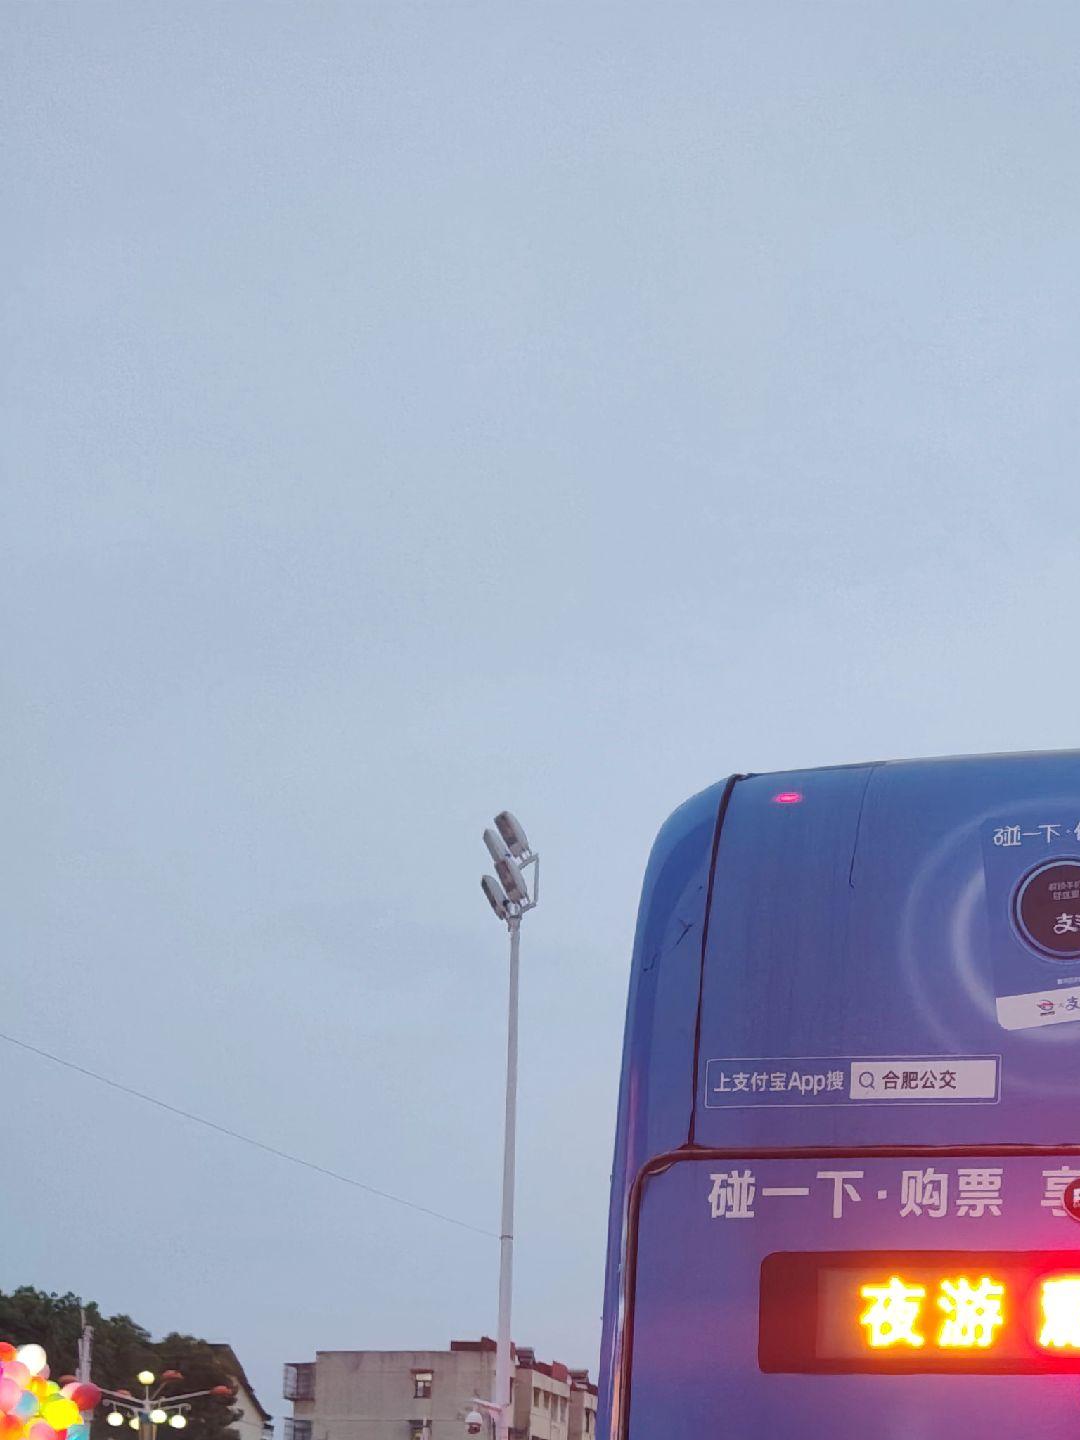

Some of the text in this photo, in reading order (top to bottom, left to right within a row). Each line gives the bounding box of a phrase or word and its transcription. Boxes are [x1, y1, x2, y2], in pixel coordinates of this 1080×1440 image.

[713, 1069, 957, 1095] 上支付宝App搜 合肥公交
[860, 1276, 1005, 1348] 夜游
